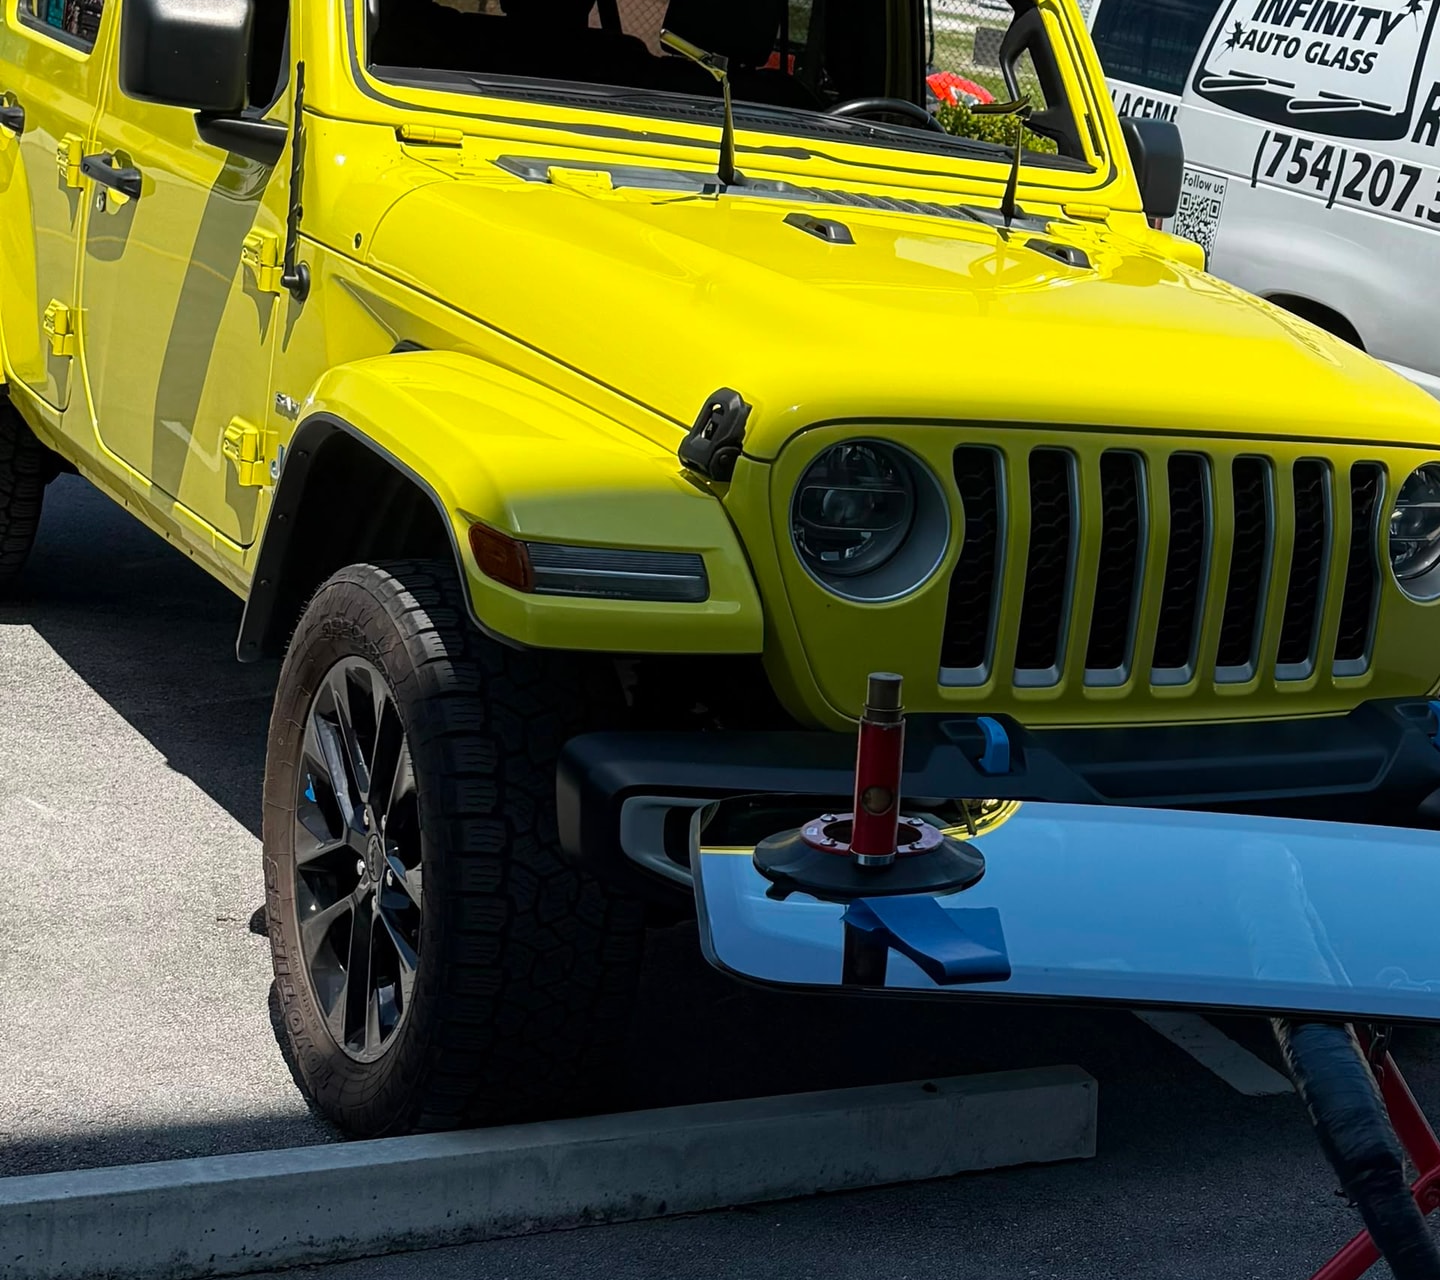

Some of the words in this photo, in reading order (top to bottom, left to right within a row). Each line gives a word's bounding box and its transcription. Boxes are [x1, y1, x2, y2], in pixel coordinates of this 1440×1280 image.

[1239, 29, 1301, 59] AUTO
[1304, 41, 1379, 74] GLASS
[1183, 172, 1212, 192] Follow
[1213, 184, 1224, 195] us
